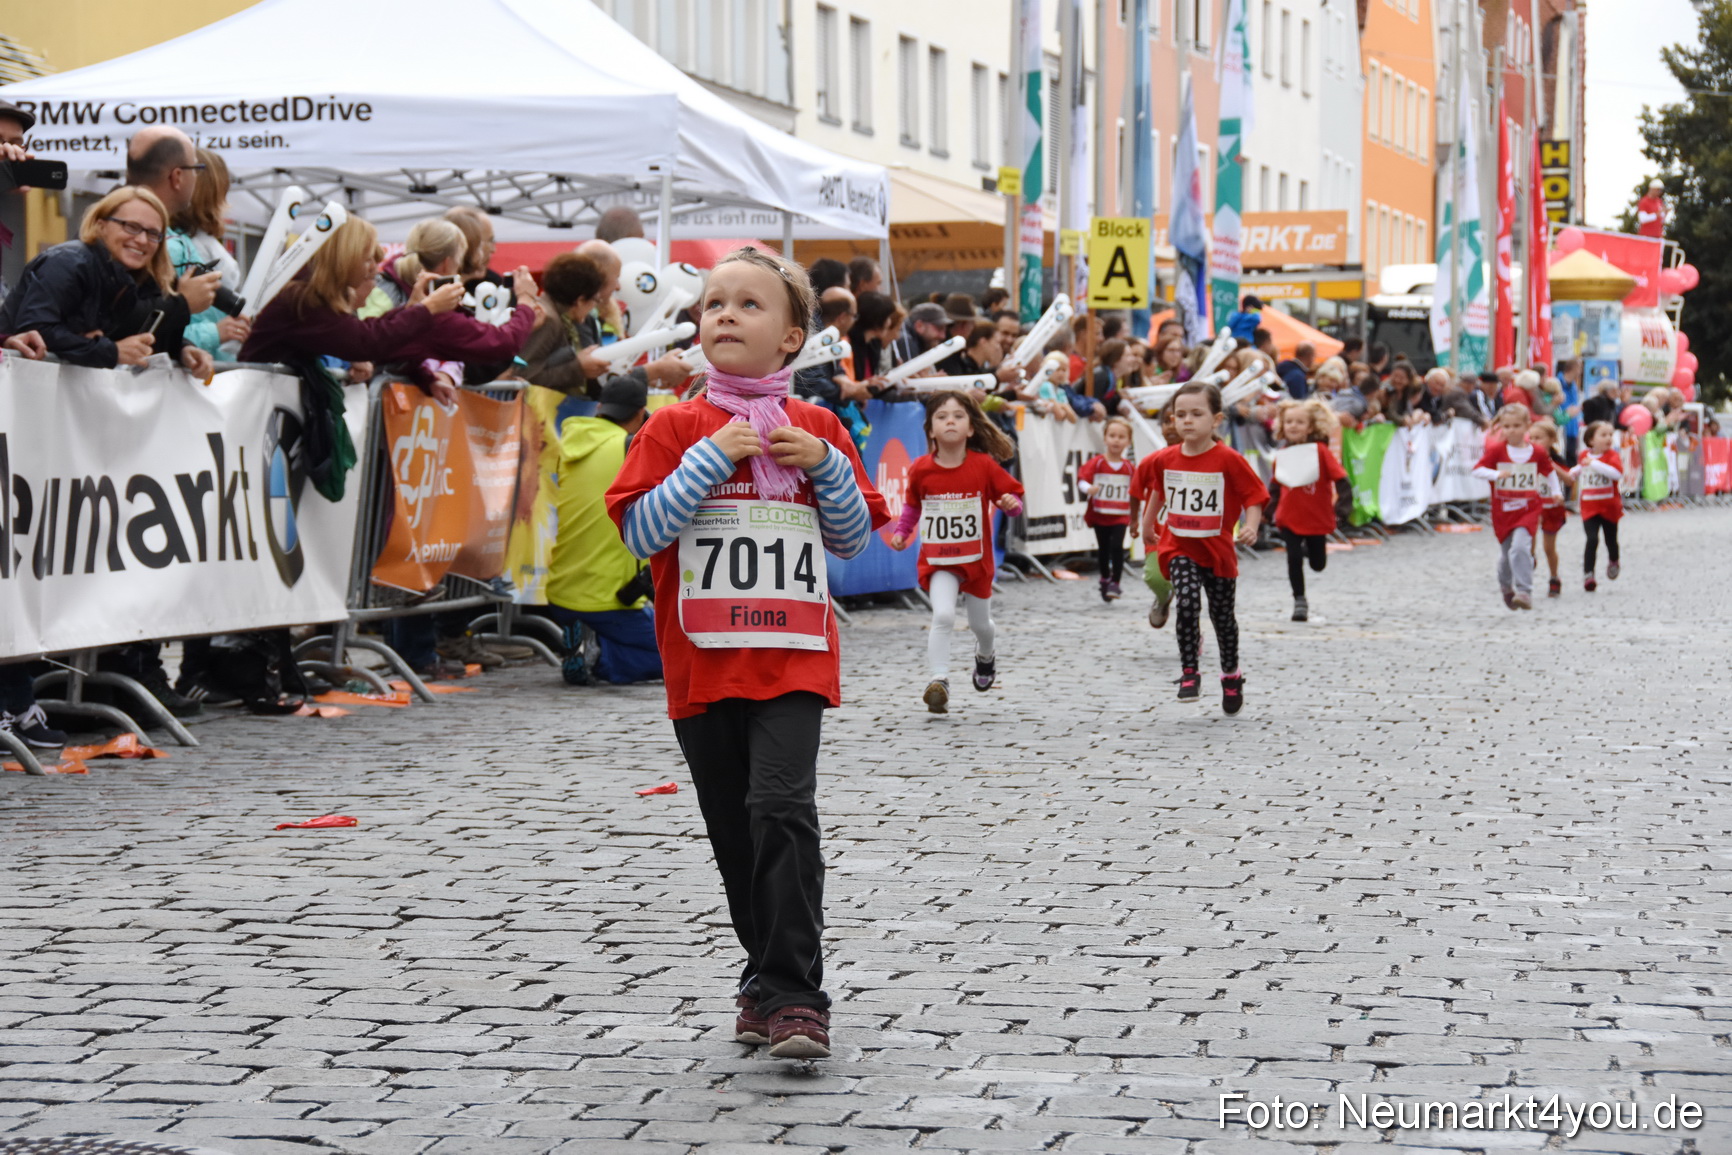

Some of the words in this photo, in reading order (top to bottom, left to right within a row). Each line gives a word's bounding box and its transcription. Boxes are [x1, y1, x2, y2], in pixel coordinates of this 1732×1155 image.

[17, 101, 105, 126] BMW
[114, 96, 372, 124] ConnectedDrive
[238, 130, 290, 149] sein.
[1098, 220, 1144, 238] Block
[1102, 245, 1135, 288] A
[1168, 486, 1218, 512] 7134
[691, 516, 740, 526] NeuerMarkt
[749, 505, 814, 529] BOCK
[925, 515, 977, 540] 7053
[696, 536, 817, 594] 7014
[730, 606, 787, 627] Fiona
